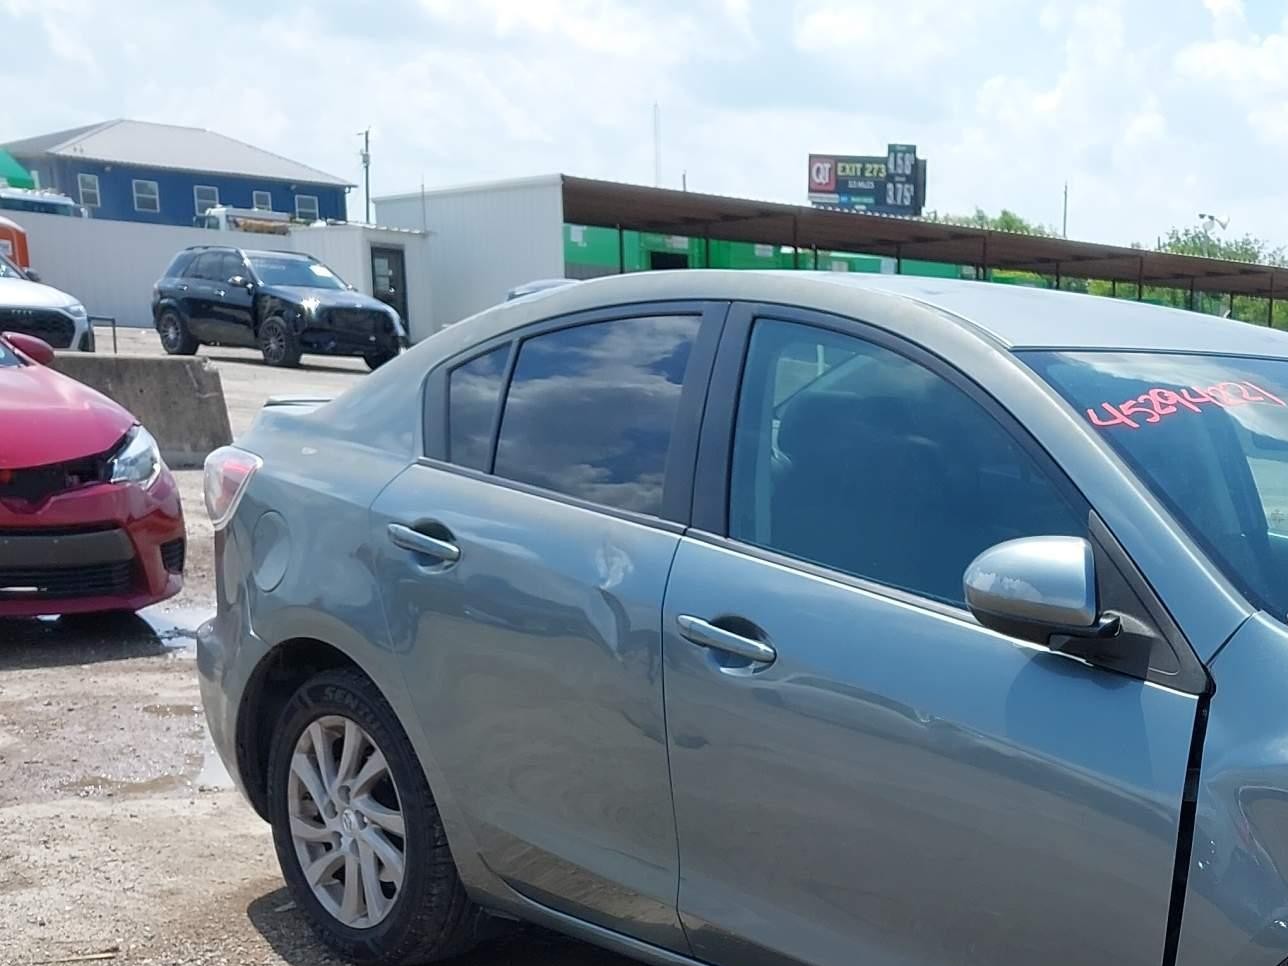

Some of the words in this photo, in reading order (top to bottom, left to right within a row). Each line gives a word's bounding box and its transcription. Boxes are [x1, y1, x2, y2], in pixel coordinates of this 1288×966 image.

[812, 162, 832, 184] QT
[837, 163, 862, 176] EXIT
[864, 164, 887, 177] 273
